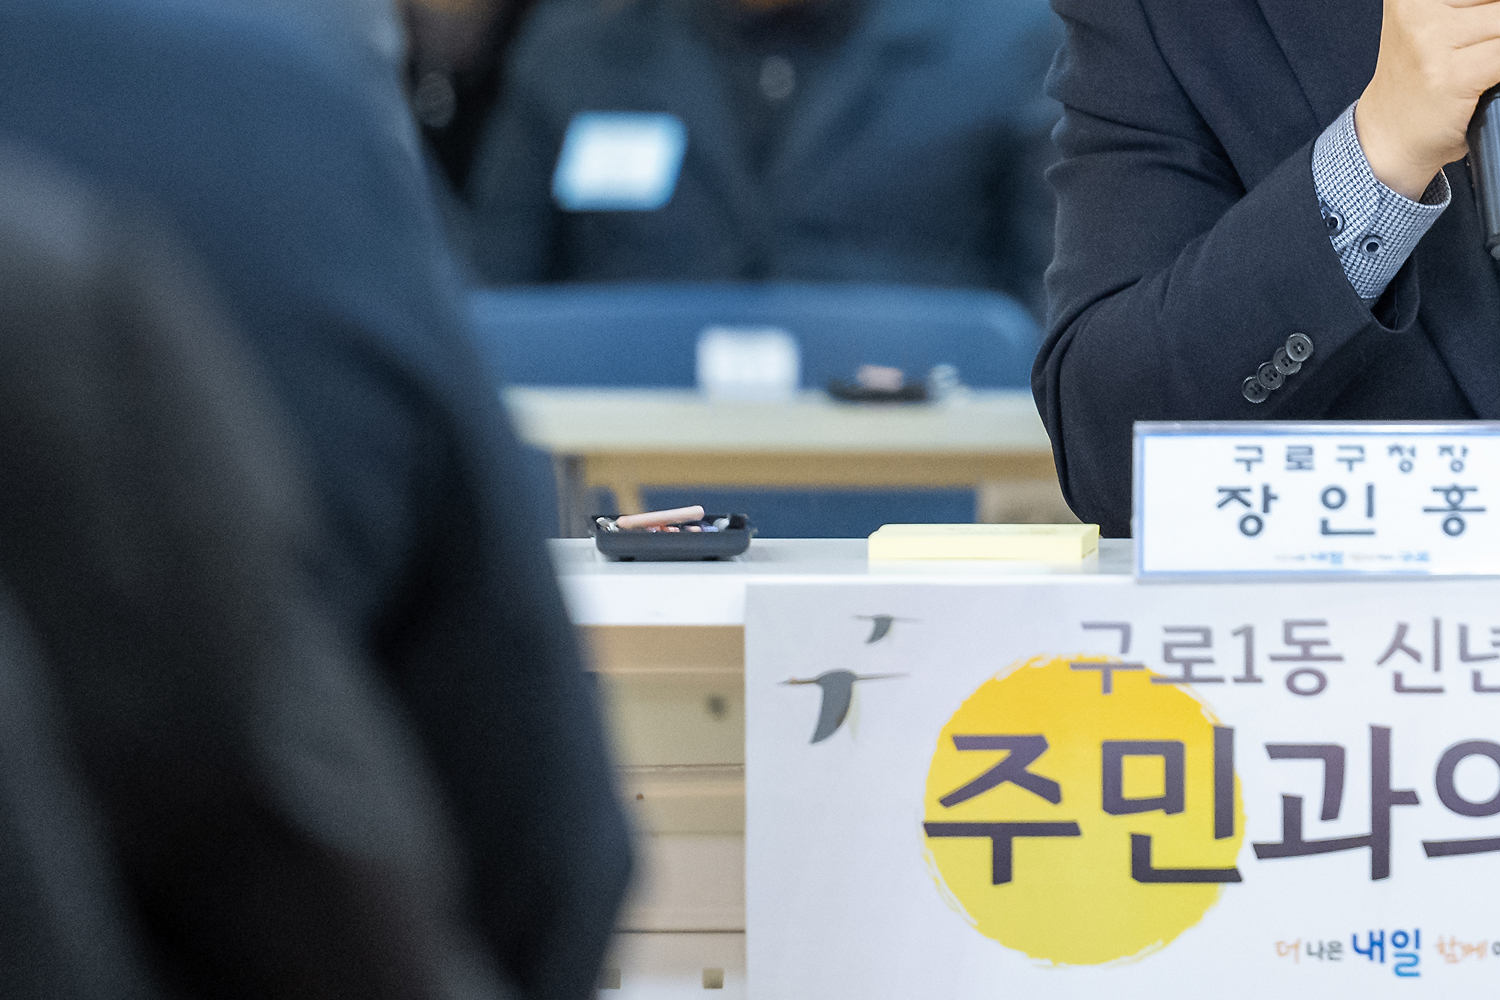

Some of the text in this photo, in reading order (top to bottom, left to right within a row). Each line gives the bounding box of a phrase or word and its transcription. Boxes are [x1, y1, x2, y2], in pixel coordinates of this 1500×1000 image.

[1070, 619, 1344, 696] 구로1동
[1275, 939, 1301, 964] 더
[1306, 940, 1344, 961] 나은
[1352, 928, 1421, 978] 내일
